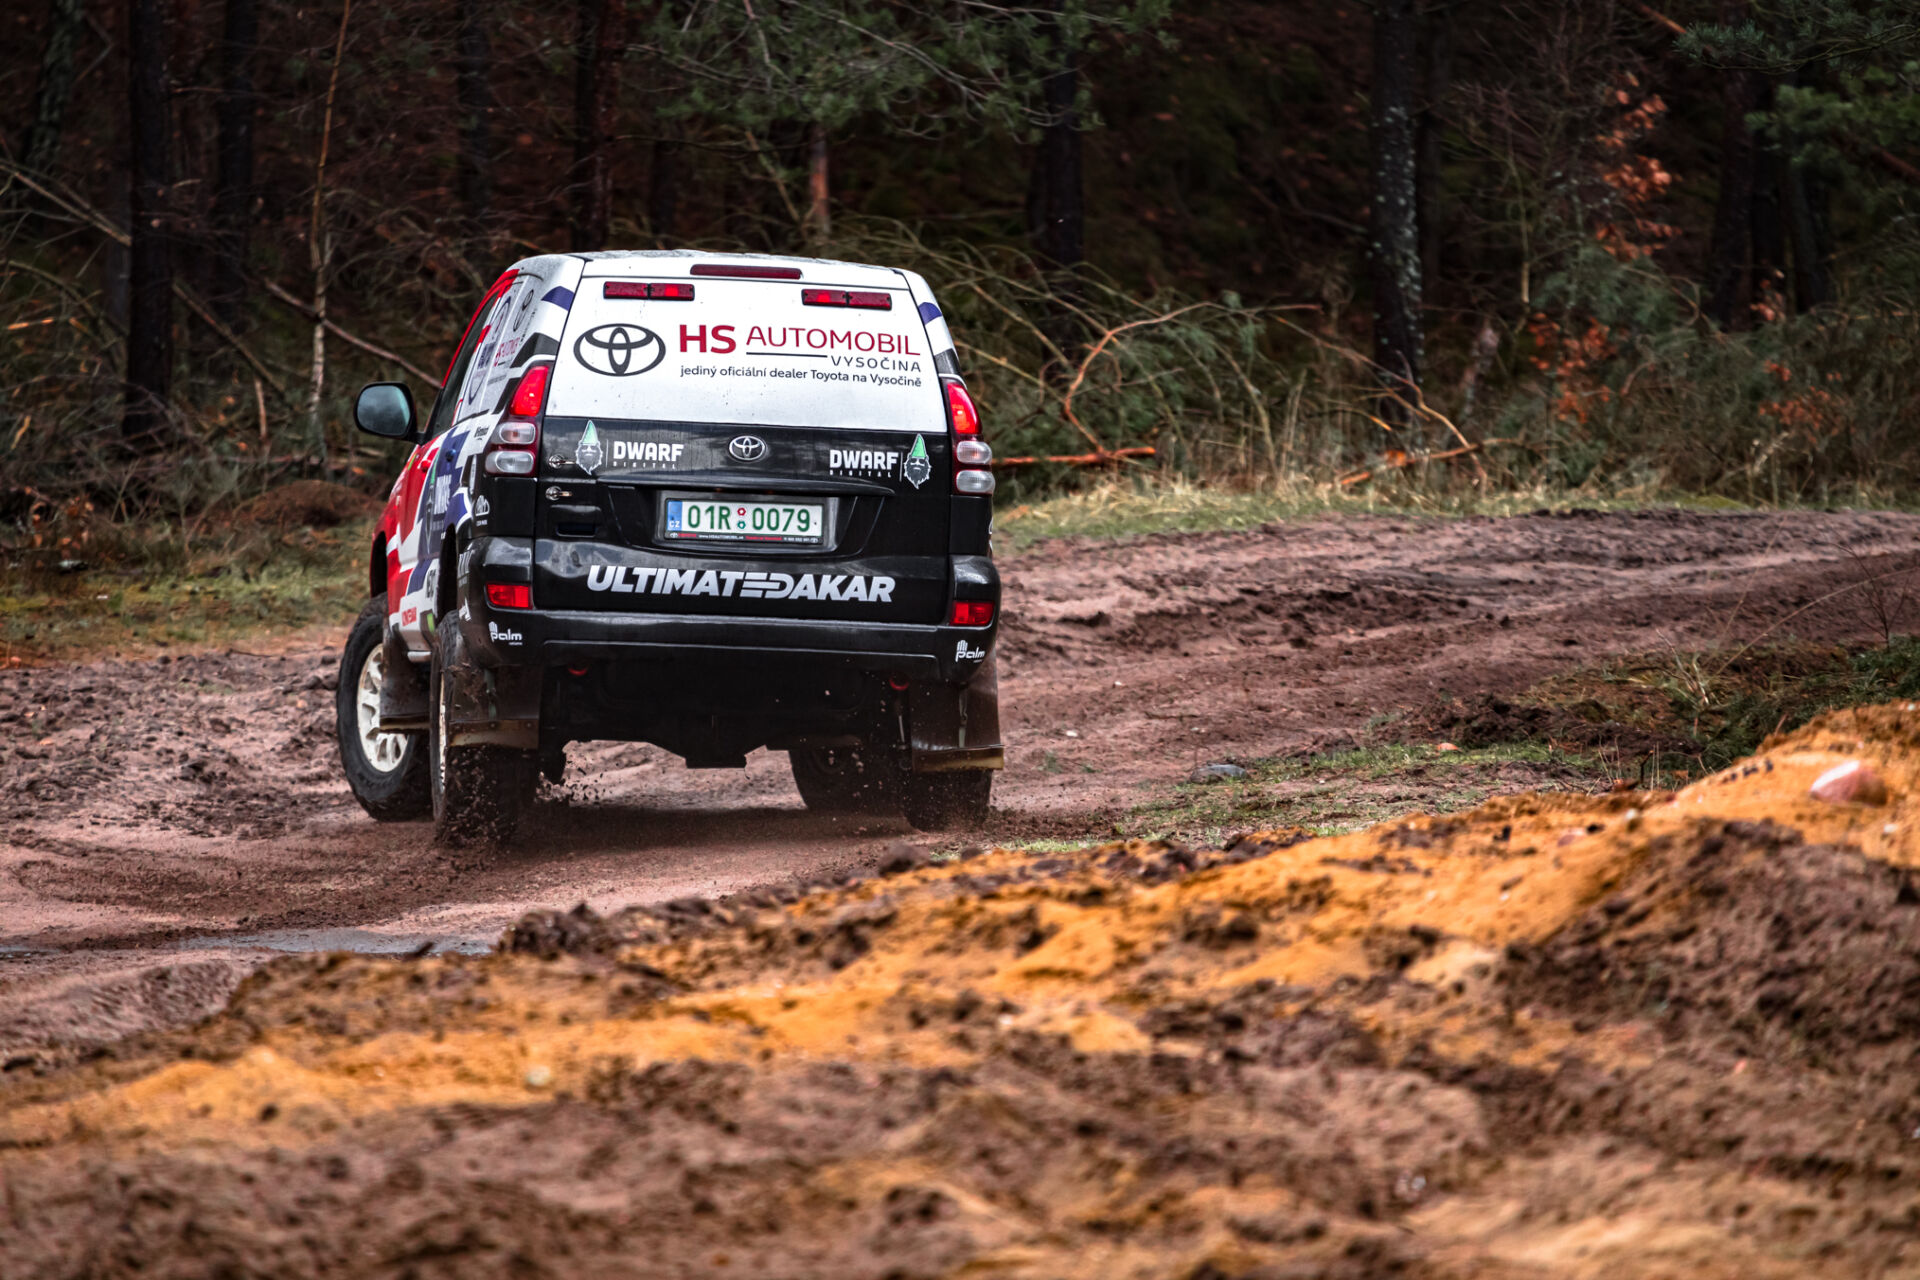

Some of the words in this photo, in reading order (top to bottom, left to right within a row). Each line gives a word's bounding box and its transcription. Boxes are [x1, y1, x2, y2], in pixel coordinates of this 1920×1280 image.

[679, 324, 737, 354] HS
[746, 325, 921, 356] AUTOMOBIL
[830, 354, 922, 373] VYSOČINA
[680, 364, 717, 378] jediný
[719, 365, 767, 378] oficiální
[769, 366, 807, 379] dealer
[811, 369, 849, 383] Toyota
[852, 373, 867, 383] na
[870, 373, 922, 388] Vysočině
[613, 440, 684, 462] DWARF
[829, 449, 899, 471] DWARF
[687, 504, 731, 531] 01R
[752, 507, 811, 533] 0079
